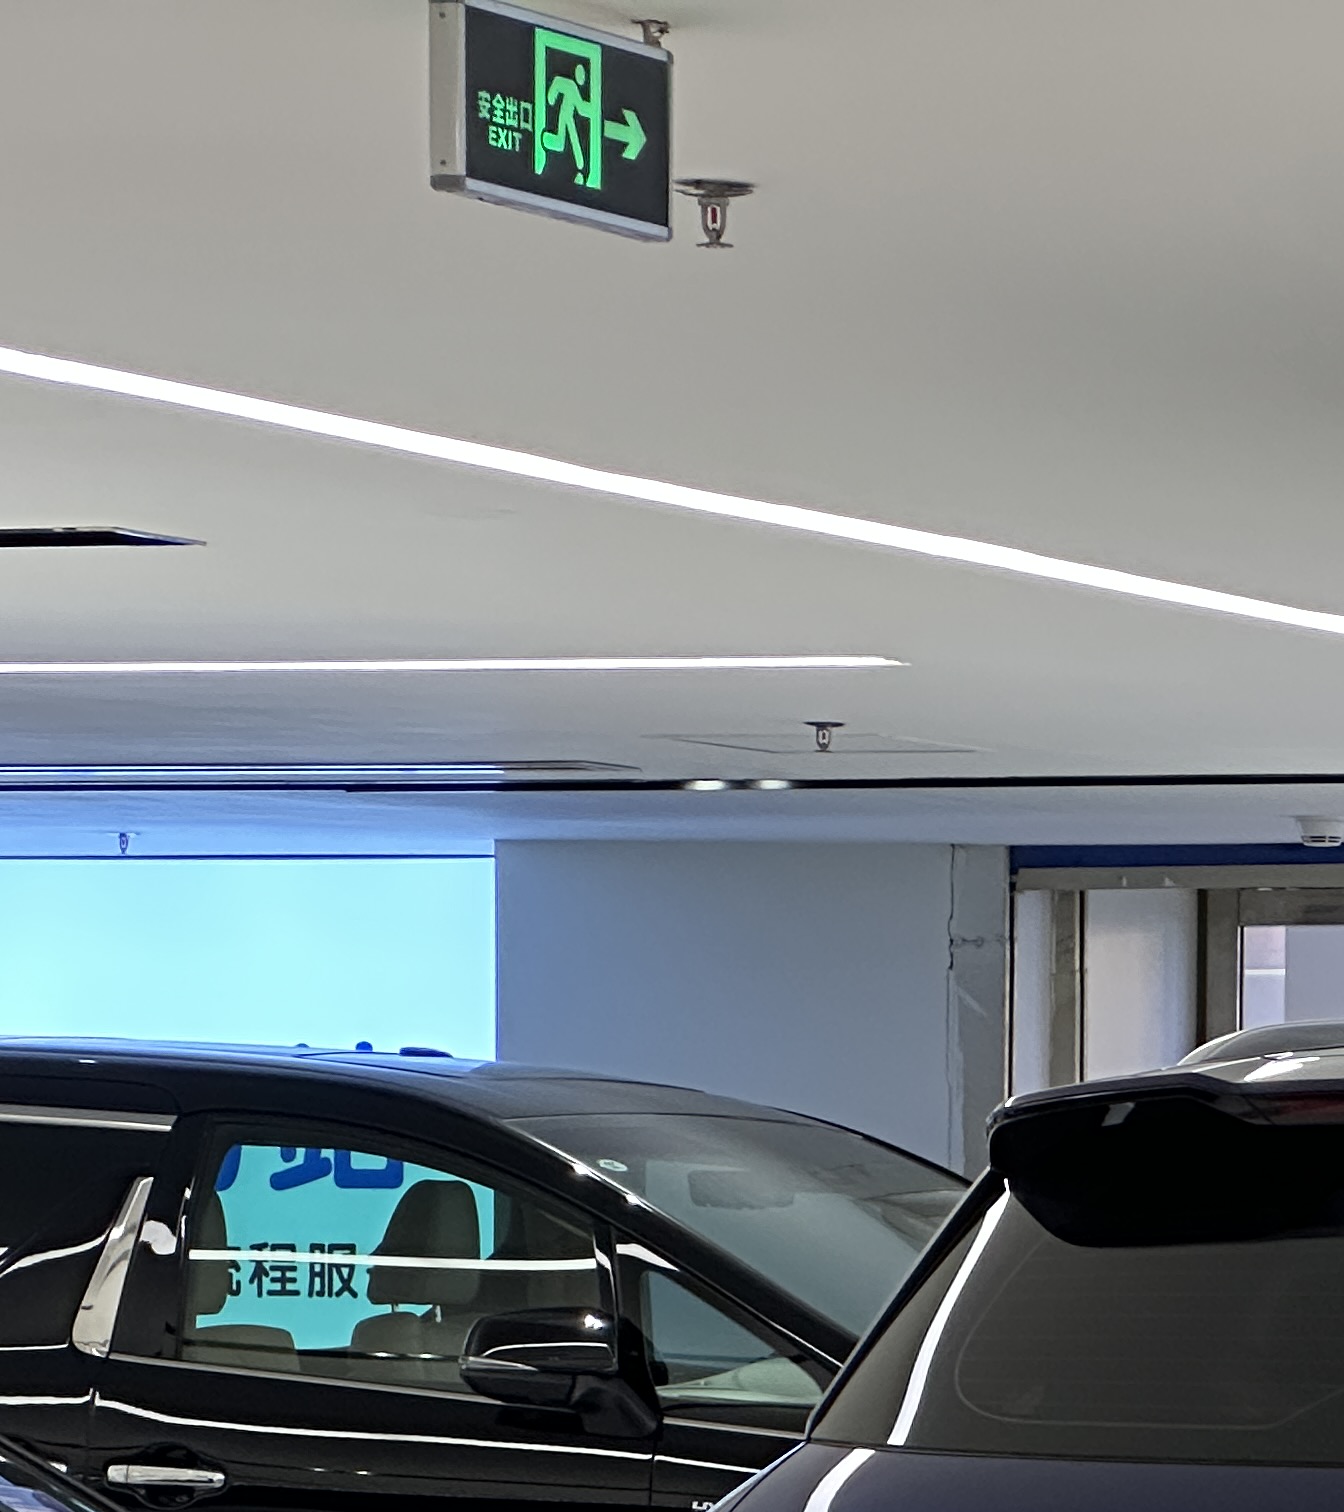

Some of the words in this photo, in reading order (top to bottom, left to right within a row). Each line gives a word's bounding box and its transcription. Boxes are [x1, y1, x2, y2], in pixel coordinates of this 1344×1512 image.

[477, 90, 533, 133] 安全出口
[488, 125, 523, 152] EXIT
